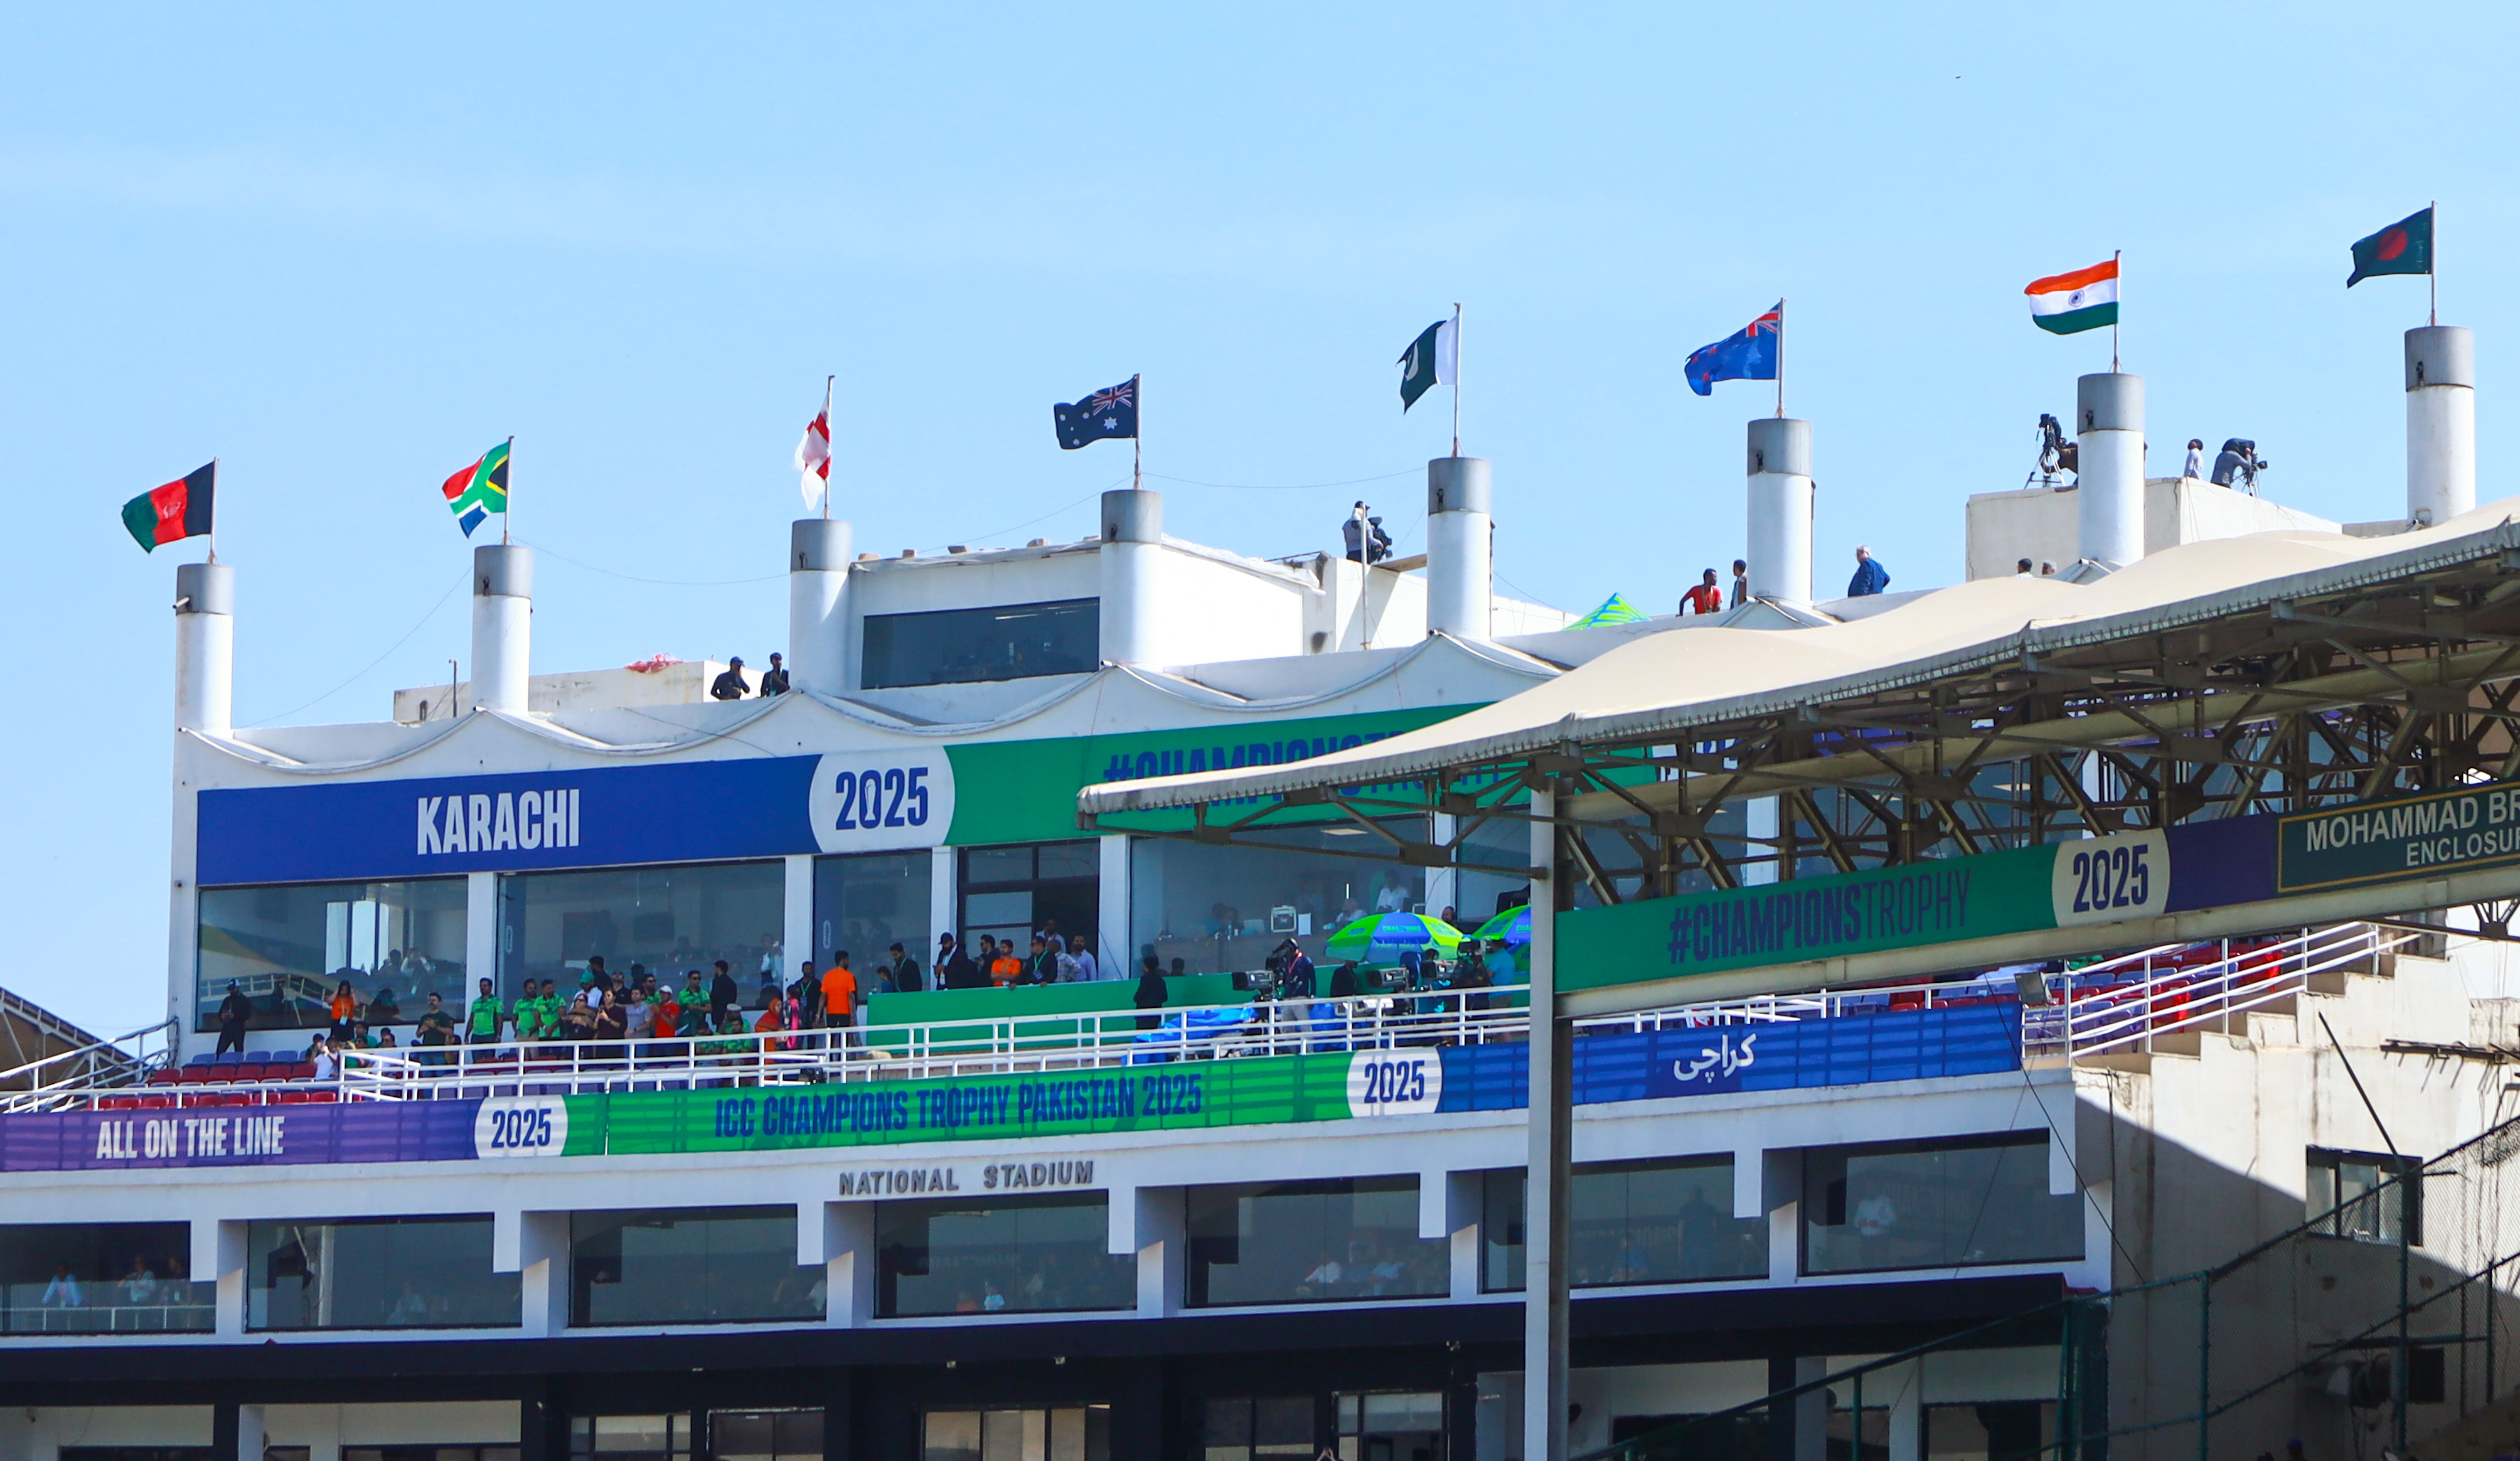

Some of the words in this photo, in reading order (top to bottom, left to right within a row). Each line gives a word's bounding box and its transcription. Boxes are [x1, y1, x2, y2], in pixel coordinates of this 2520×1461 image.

[417, 788, 580, 855] KARACHI
[836, 766, 929, 830] 2025
[2307, 796, 2479, 852] MOHAMMAD
[2073, 844, 2149, 914] 2025
[1668, 868, 1972, 965] #CHAMPIONSTROPHY
[1364, 1060, 1425, 1104] 2025
[1673, 1033, 1757, 1084] کراچی
[492, 1108, 552, 1148] 2025
[715, 1096, 755, 1137] ICC
[762, 1091, 908, 1135] CHAMPIONS
[917, 1084, 1008, 1129] TROPHY
[1018, 1078, 1135, 1123] PAKISTAN
[1143, 1073, 1201, 1116] 2025
[97, 1120, 138, 1159] ALL
[144, 1119, 179, 1158] ON
[185, 1118, 227, 1157] THE
[234, 1115, 286, 1155] LINE
[839, 1168, 958, 1196] NATIONAL
[983, 1160, 1094, 1189] STADIUM
